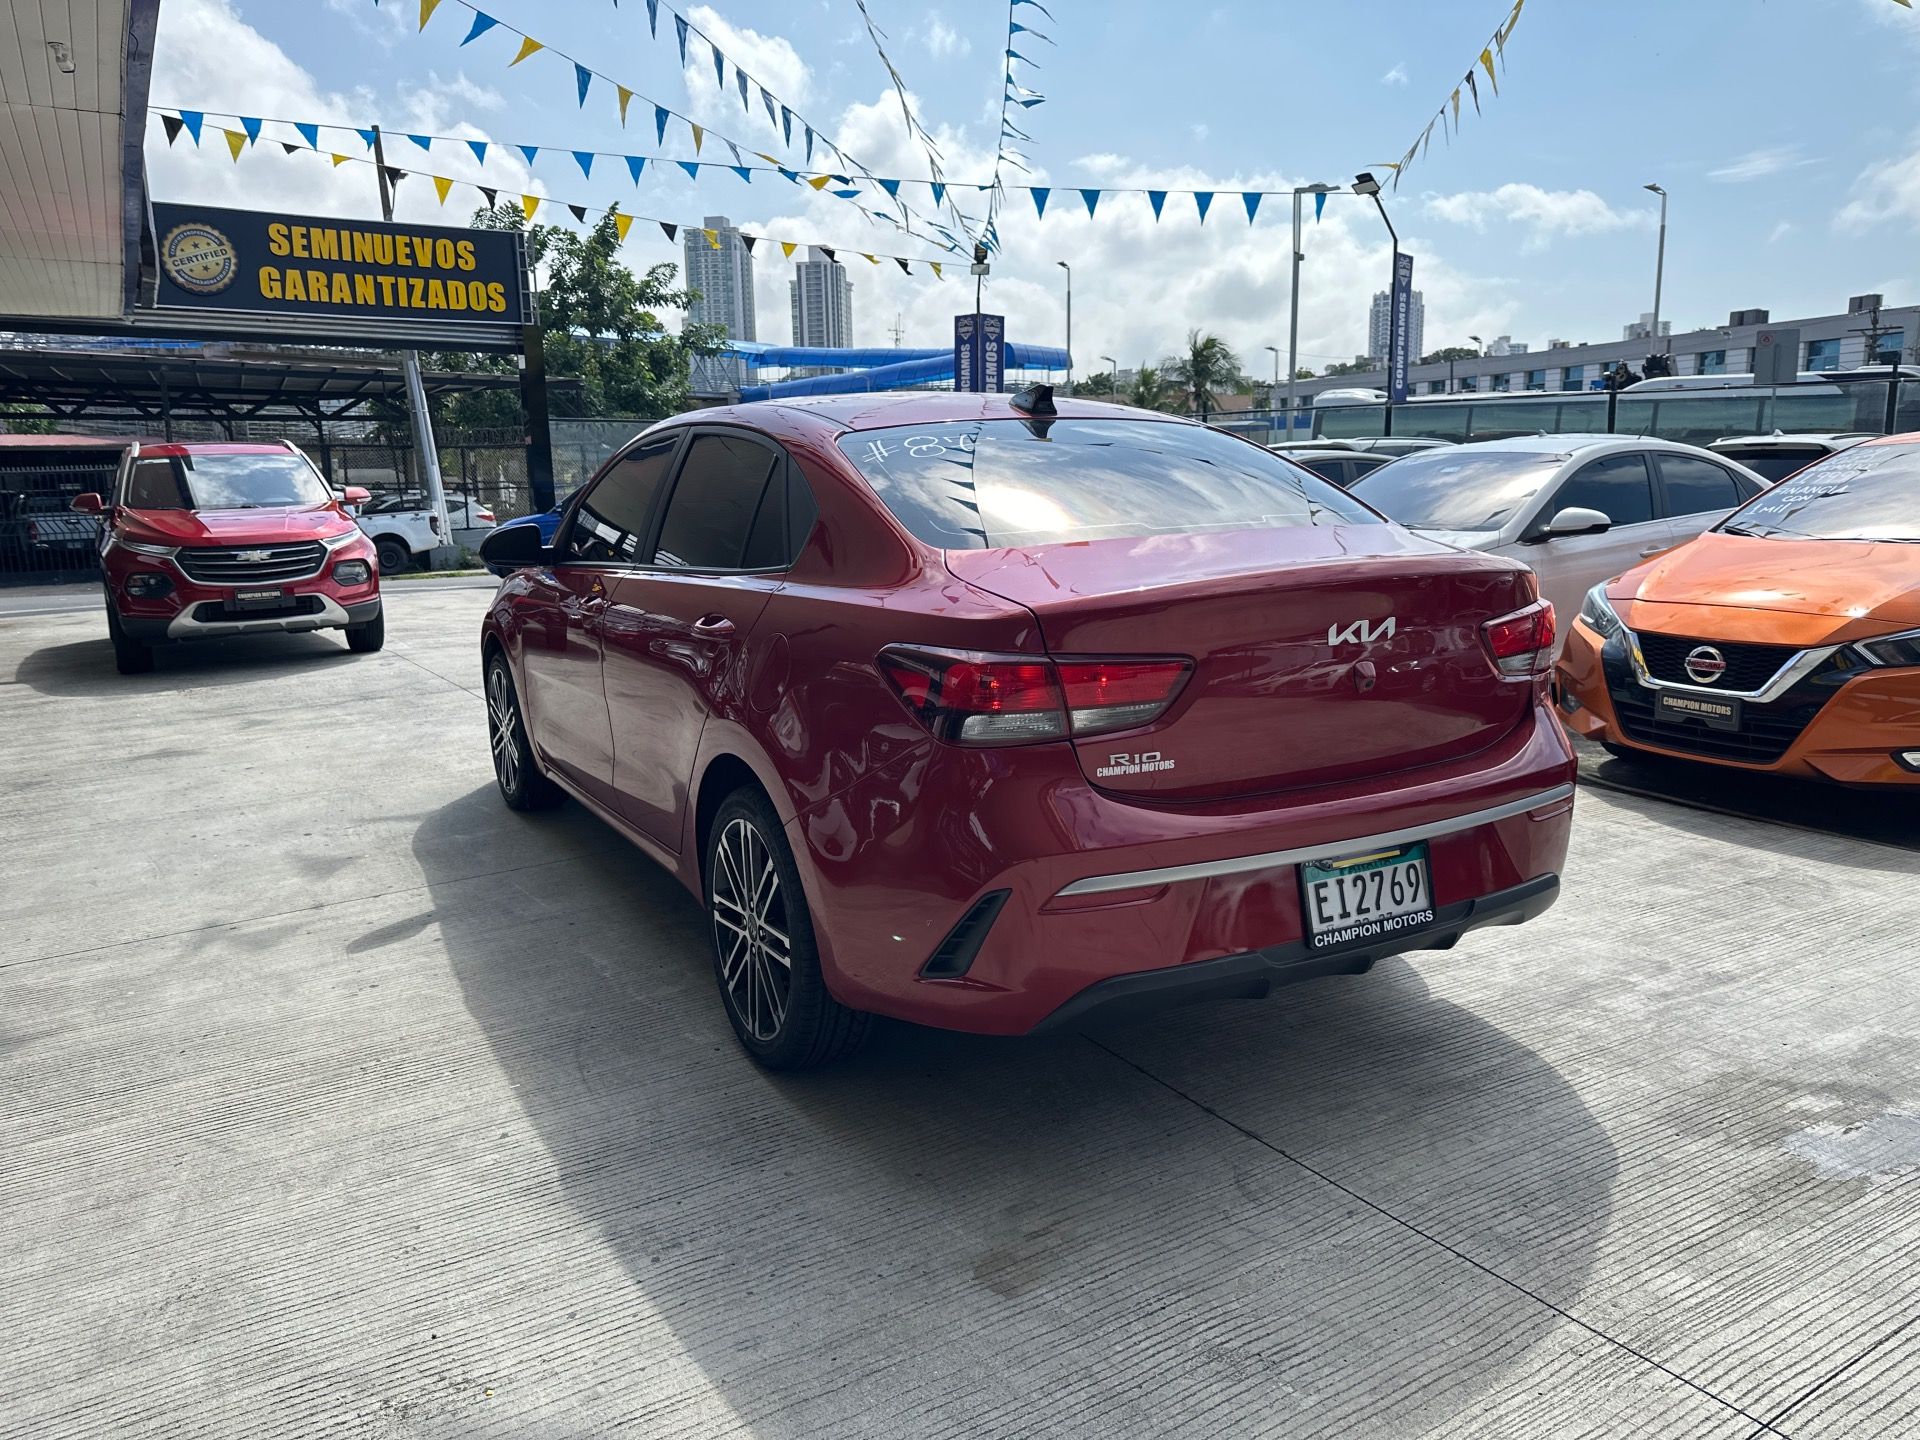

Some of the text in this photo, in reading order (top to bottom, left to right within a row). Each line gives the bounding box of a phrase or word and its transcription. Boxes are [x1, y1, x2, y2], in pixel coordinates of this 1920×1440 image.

[172, 248, 228, 267] CERTIFIED
[268, 223, 476, 271] SEMINUEVOS
[258, 266, 507, 312] GARANTIZADOS
[1396, 292, 1407, 389] COMPRAMOS
[1328, 616, 1396, 646] KIA
[1663, 697, 1700, 710] CHAMPION
[1700, 703, 1731, 715] MOTORS
[1096, 760, 1175, 777] CHAMPION MOTORS
[1109, 751, 1161, 766] RIO
[1313, 863, 1421, 925] EI2769
[1314, 923, 1381, 947] CHAMPION
[1383, 910, 1434, 931] MOTORS
